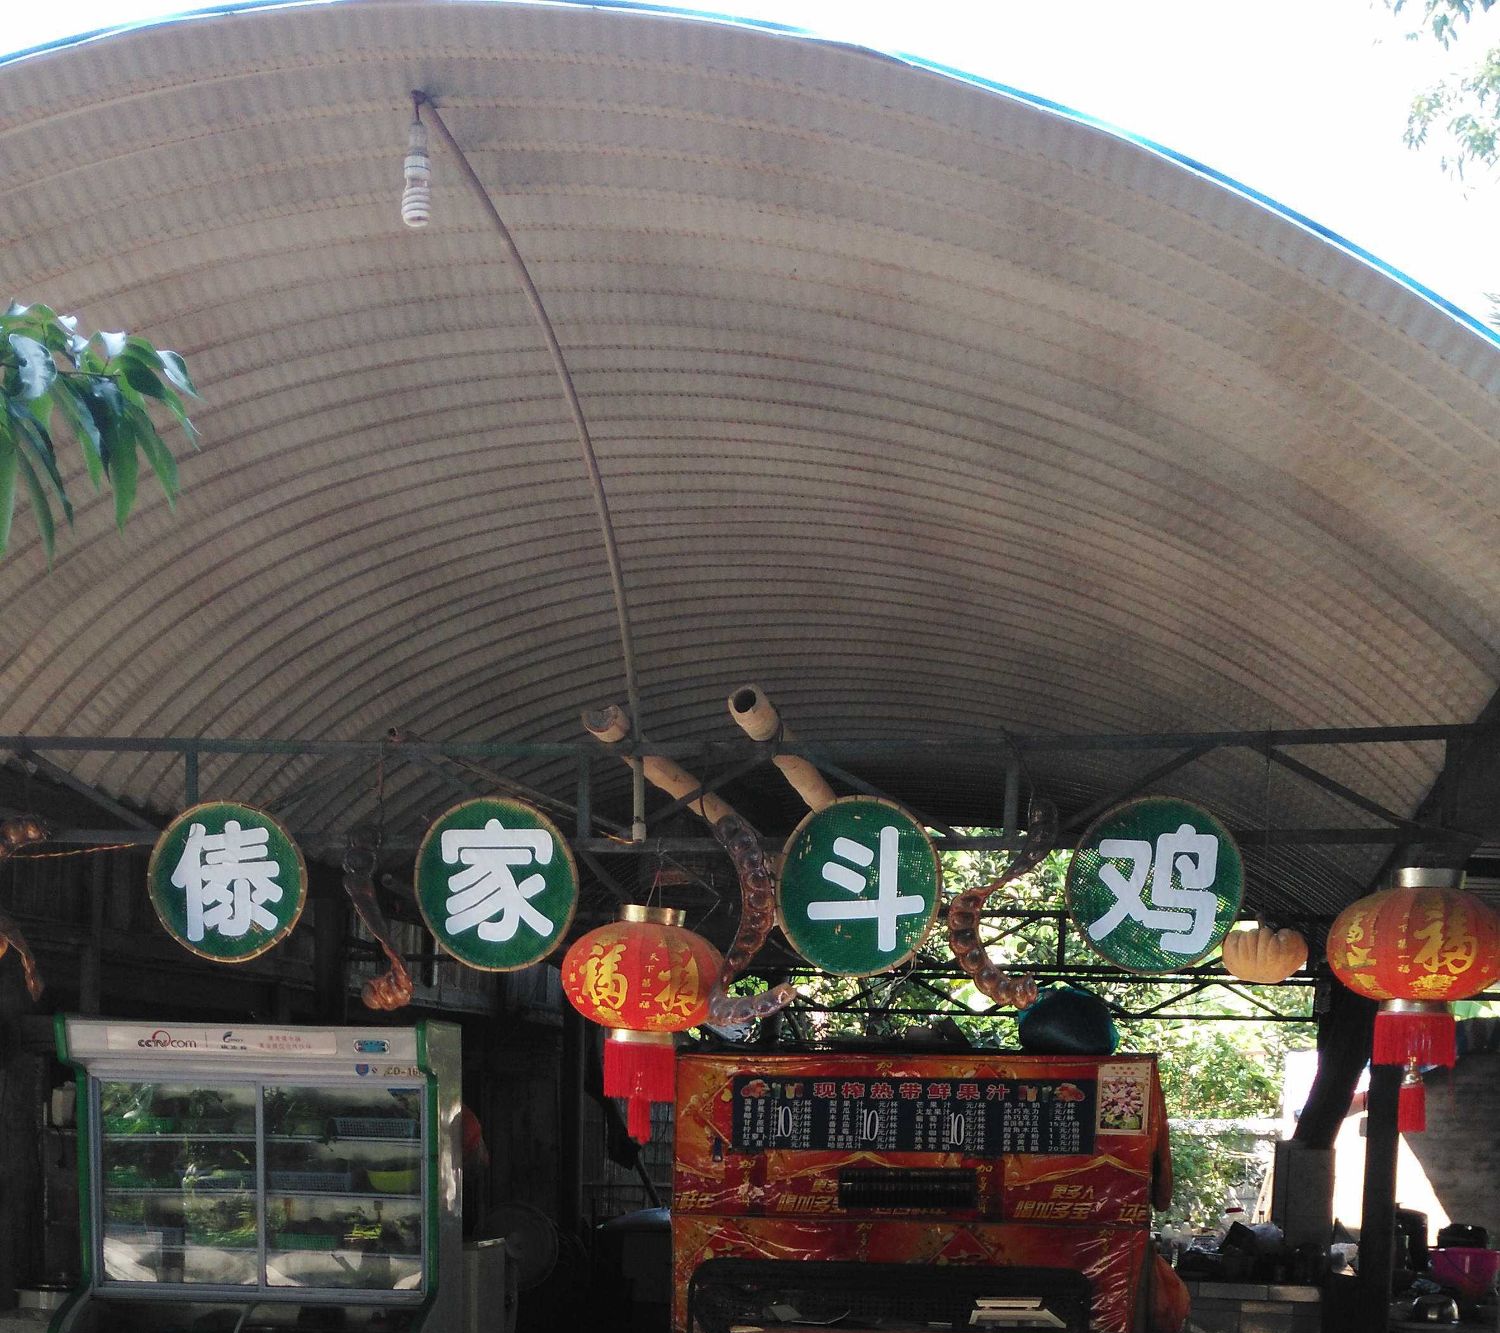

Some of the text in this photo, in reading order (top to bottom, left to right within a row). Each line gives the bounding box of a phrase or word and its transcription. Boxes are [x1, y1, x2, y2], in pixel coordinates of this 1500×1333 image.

[172, 821, 283, 941] 傣
[442, 819, 553, 941] 家
[808, 826, 924, 951] 斗
[1089, 823, 1218, 956] 鸡
[579, 944, 627, 1010] 福
[813, 1082, 1009, 1101] 现榨热带鲜果汁
[775, 1106, 792, 1138] 10
[861, 1109, 879, 1141] 10
[950, 1112, 965, 1145] 10
[1050, 1184, 1095, 1200] 更多人
[1013, 1200, 1093, 1220] 喝加多宝
